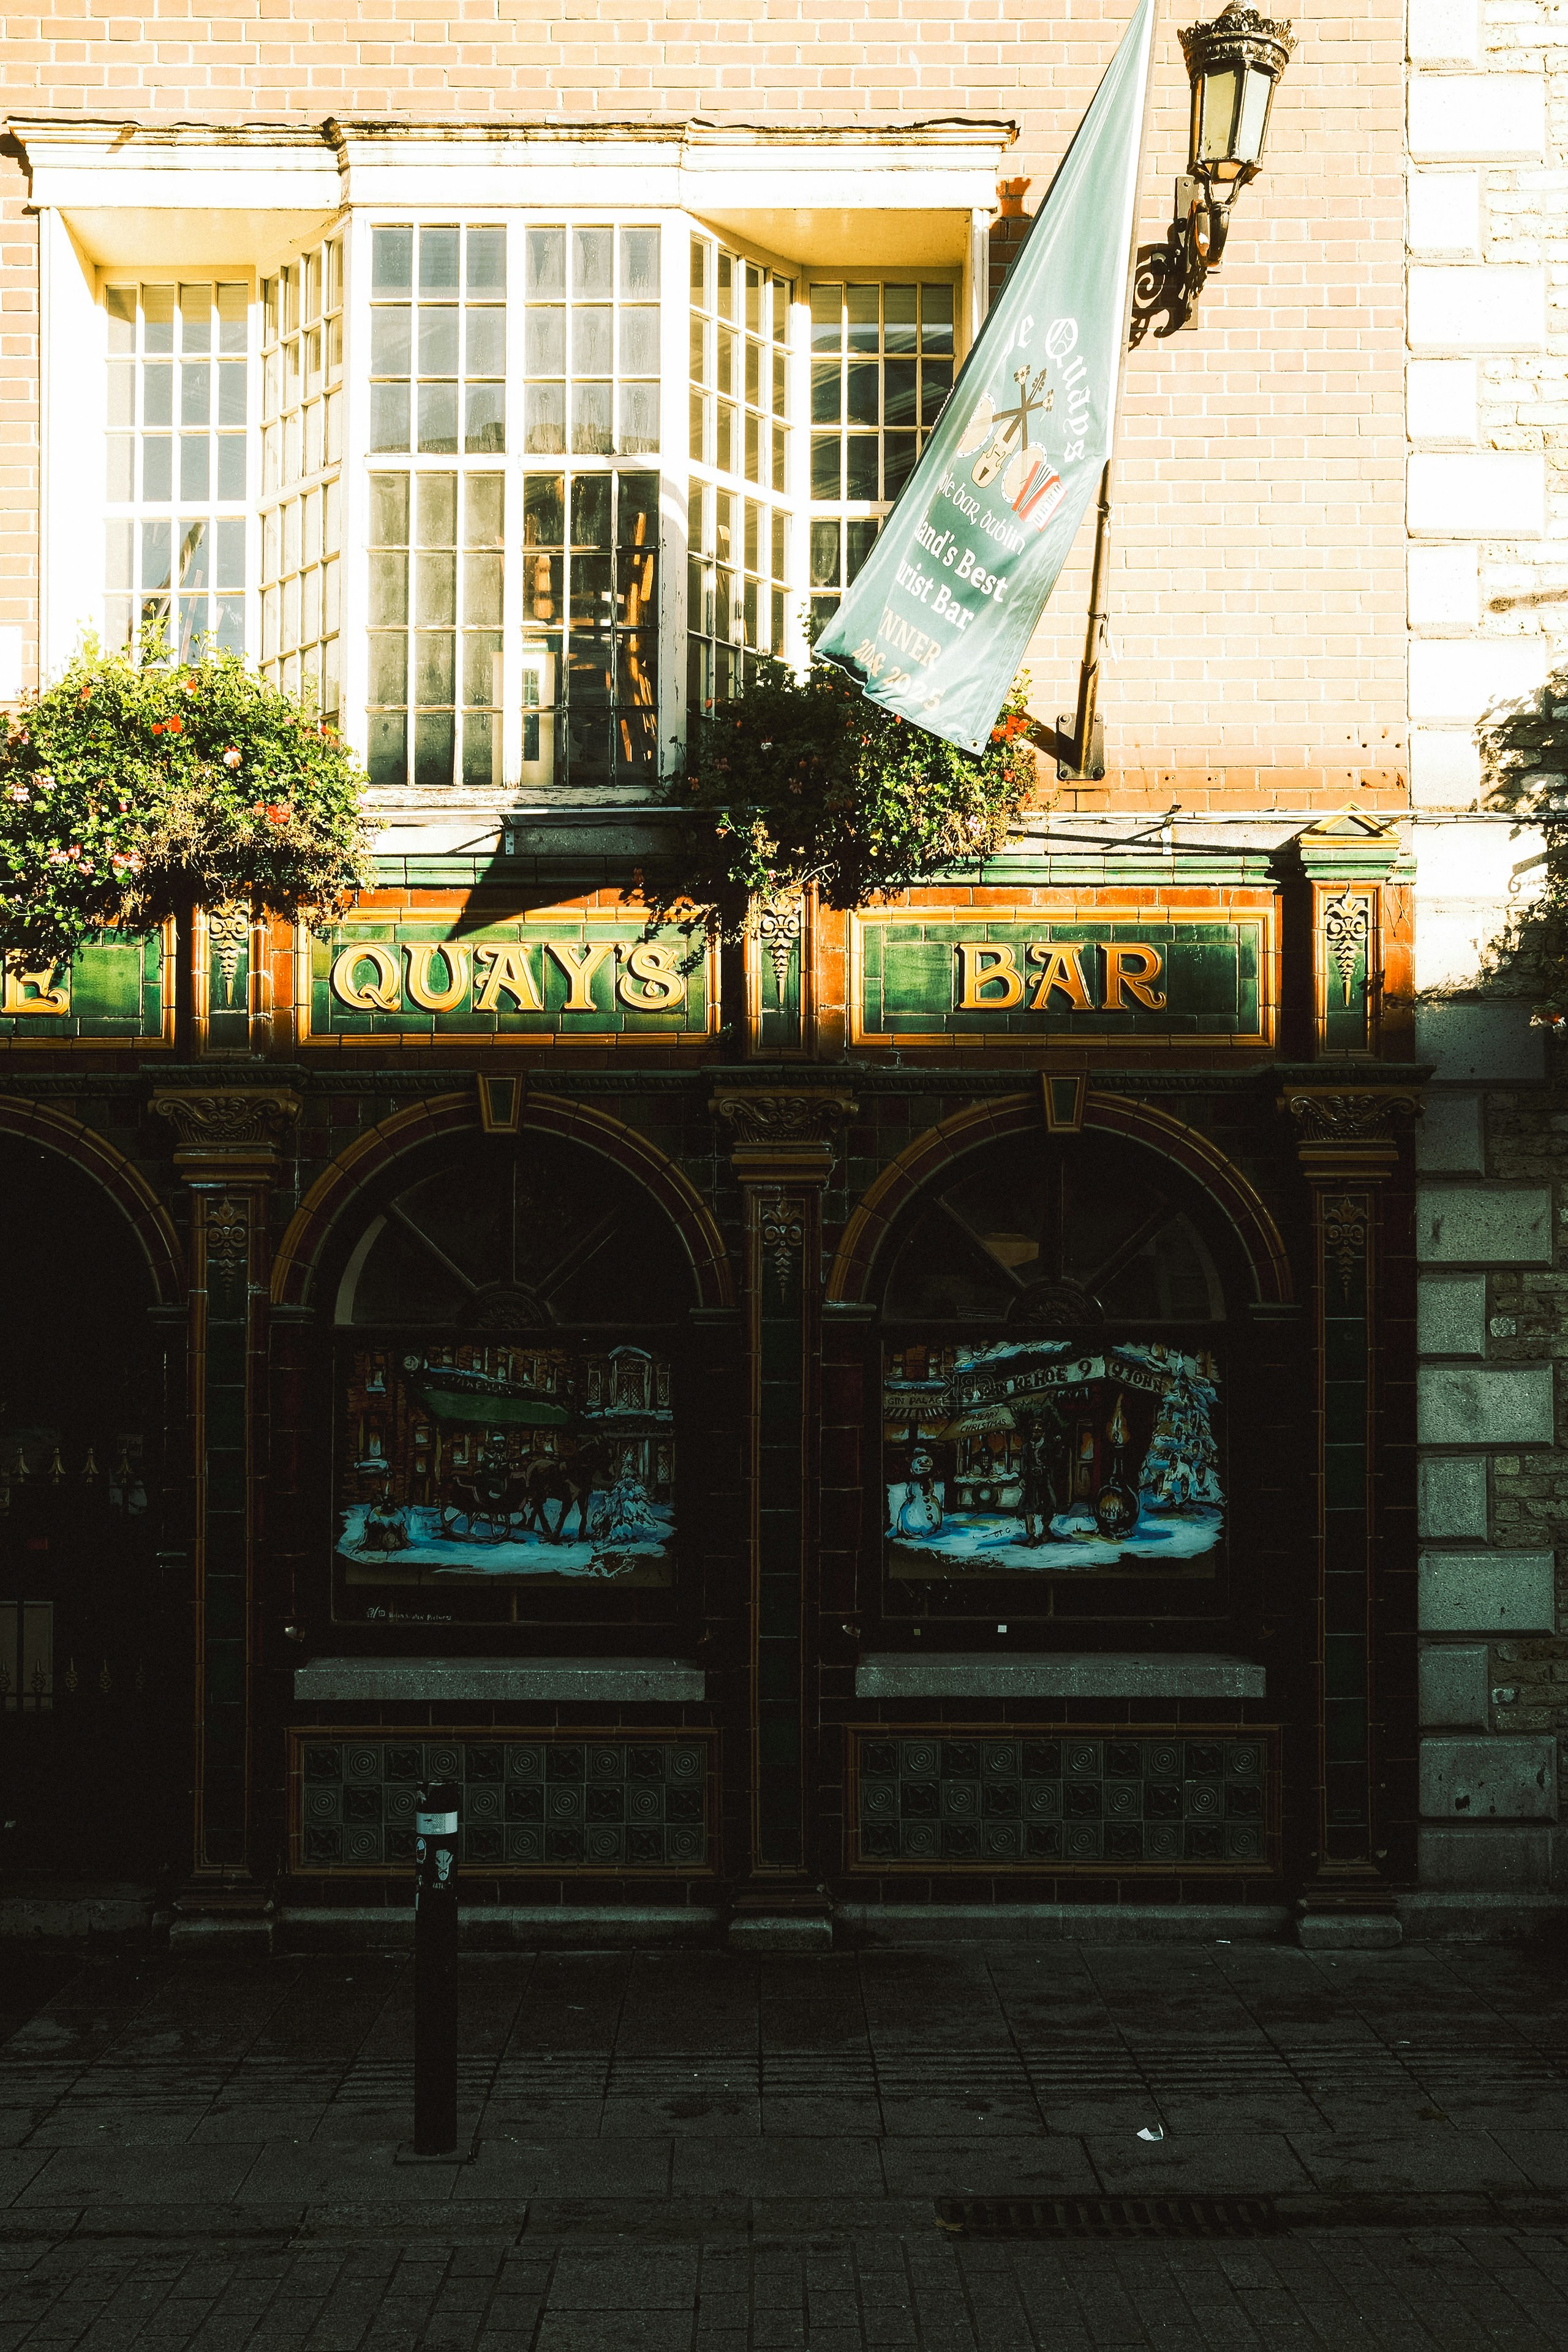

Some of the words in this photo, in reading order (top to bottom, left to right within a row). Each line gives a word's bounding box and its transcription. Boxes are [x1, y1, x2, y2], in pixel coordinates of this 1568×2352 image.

[1045, 317, 1091, 462] Quays
[954, 548, 1009, 603] Best
[930, 583, 975, 631] Bar
[330, 943, 687, 1012] QUAY'S
[957, 942, 1167, 1012] BAR
[1014, 1365, 1068, 1390] KEHOE
[1078, 1359, 1092, 1379] 9
[1112, 1362, 1124, 1378] 9
[960, 1419, 1006, 1433] CHRISTMAS
[971, 1408, 1000, 1422] MERRY
